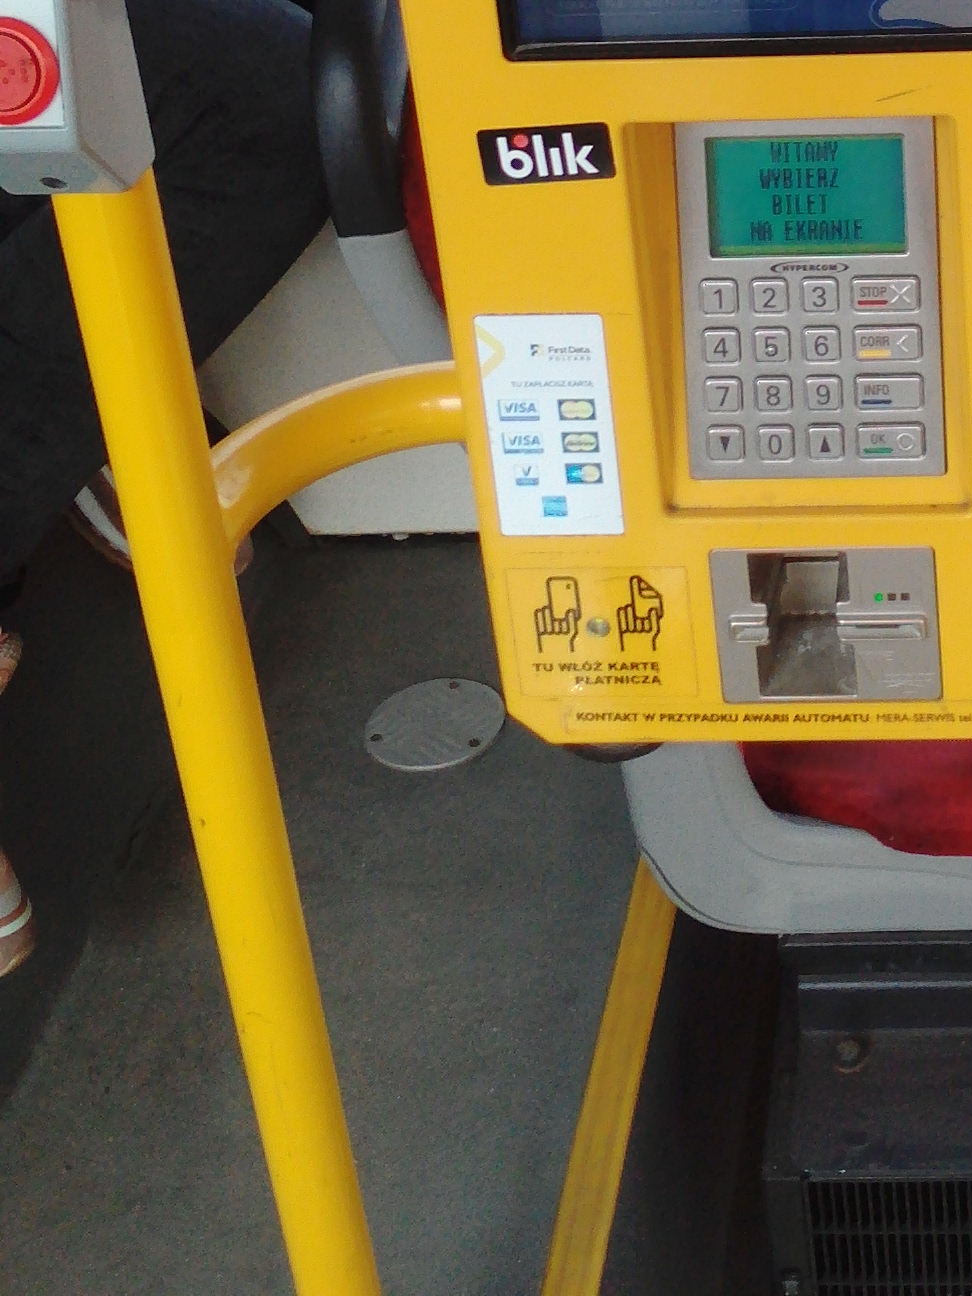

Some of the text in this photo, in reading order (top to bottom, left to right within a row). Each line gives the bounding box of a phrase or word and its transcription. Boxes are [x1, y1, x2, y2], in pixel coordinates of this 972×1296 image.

[496, 132, 599, 179] blik
[759, 168, 839, 190] WYBIERZ
[772, 194, 827, 215] BILET
[750, 219, 864, 242] NA EKRANIE
[782, 262, 838, 272] HYPERCOM
[713, 286, 887, 309] 1 2 3 STOP
[713, 337, 728, 357] 4
[764, 336, 778, 357] 5
[814, 335, 829, 356] 6
[715, 385, 890, 407] 7 8 9 INFO
[505, 402, 537, 413] VISA
[509, 435, 541, 446] VISA
[768, 434, 886, 455] 0 OK
[532, 660, 660, 673] TU WŁÓŻ KARTĘ
[575, 675, 663, 685] PŁATNICZĄ
[576, 712, 639, 723] KONTAKT
[642, 712, 656, 723] W
[659, 713, 739, 723] PRZYPADKU
[742, 713, 790, 723] AWARII
[793, 713, 870, 723] AUTOMATU
